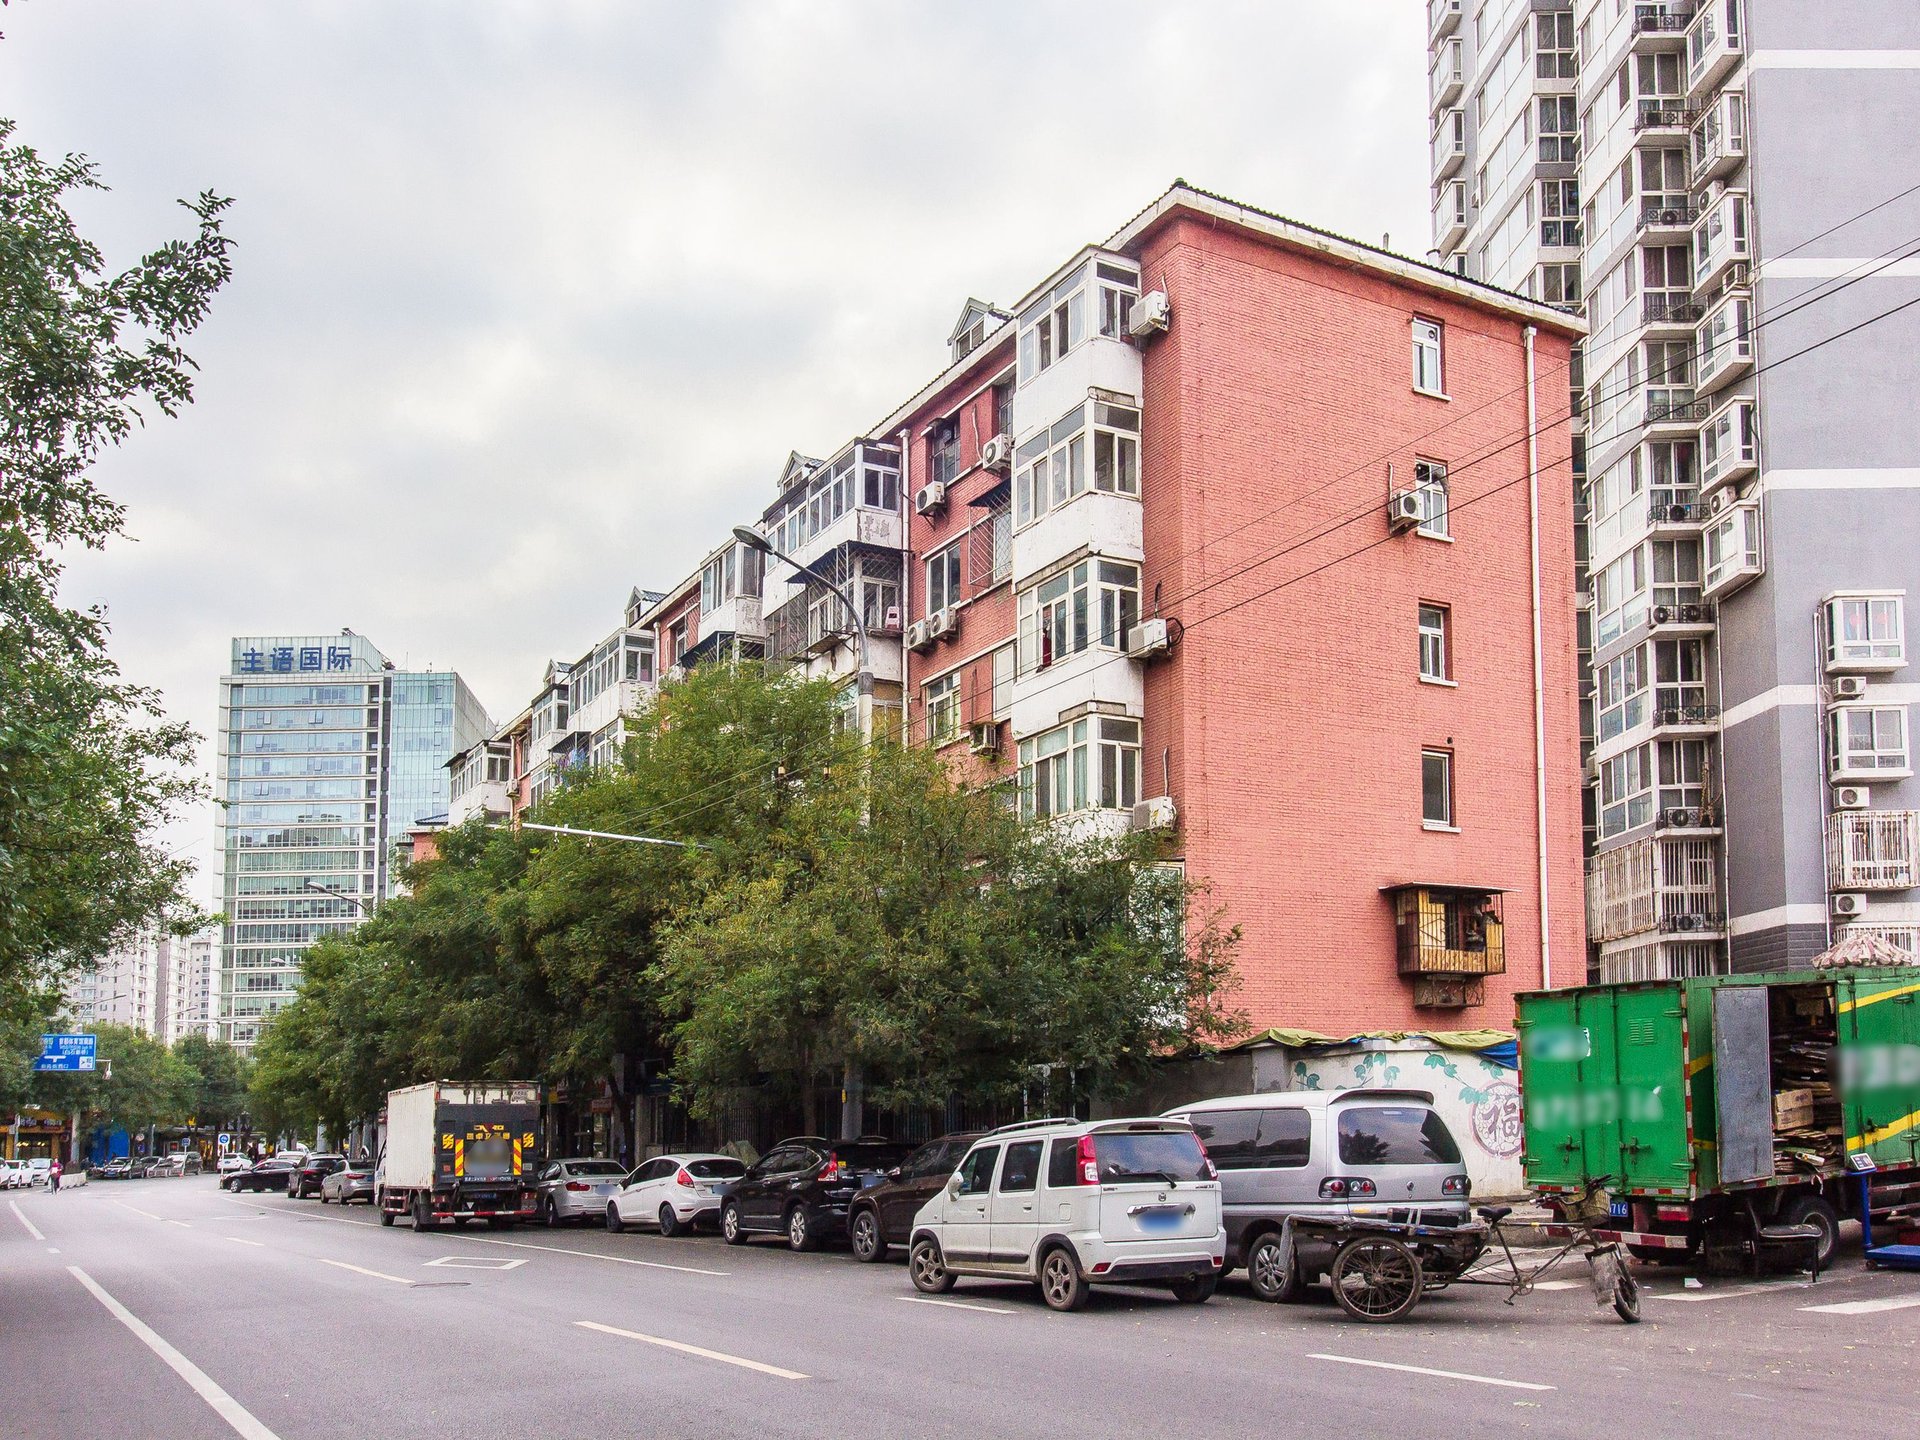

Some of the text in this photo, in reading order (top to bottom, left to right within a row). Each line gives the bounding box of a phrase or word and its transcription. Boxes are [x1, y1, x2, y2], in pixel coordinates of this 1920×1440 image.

[241, 646, 352, 672] 主语国际
[1609, 1203, 1627, 1215] 716
